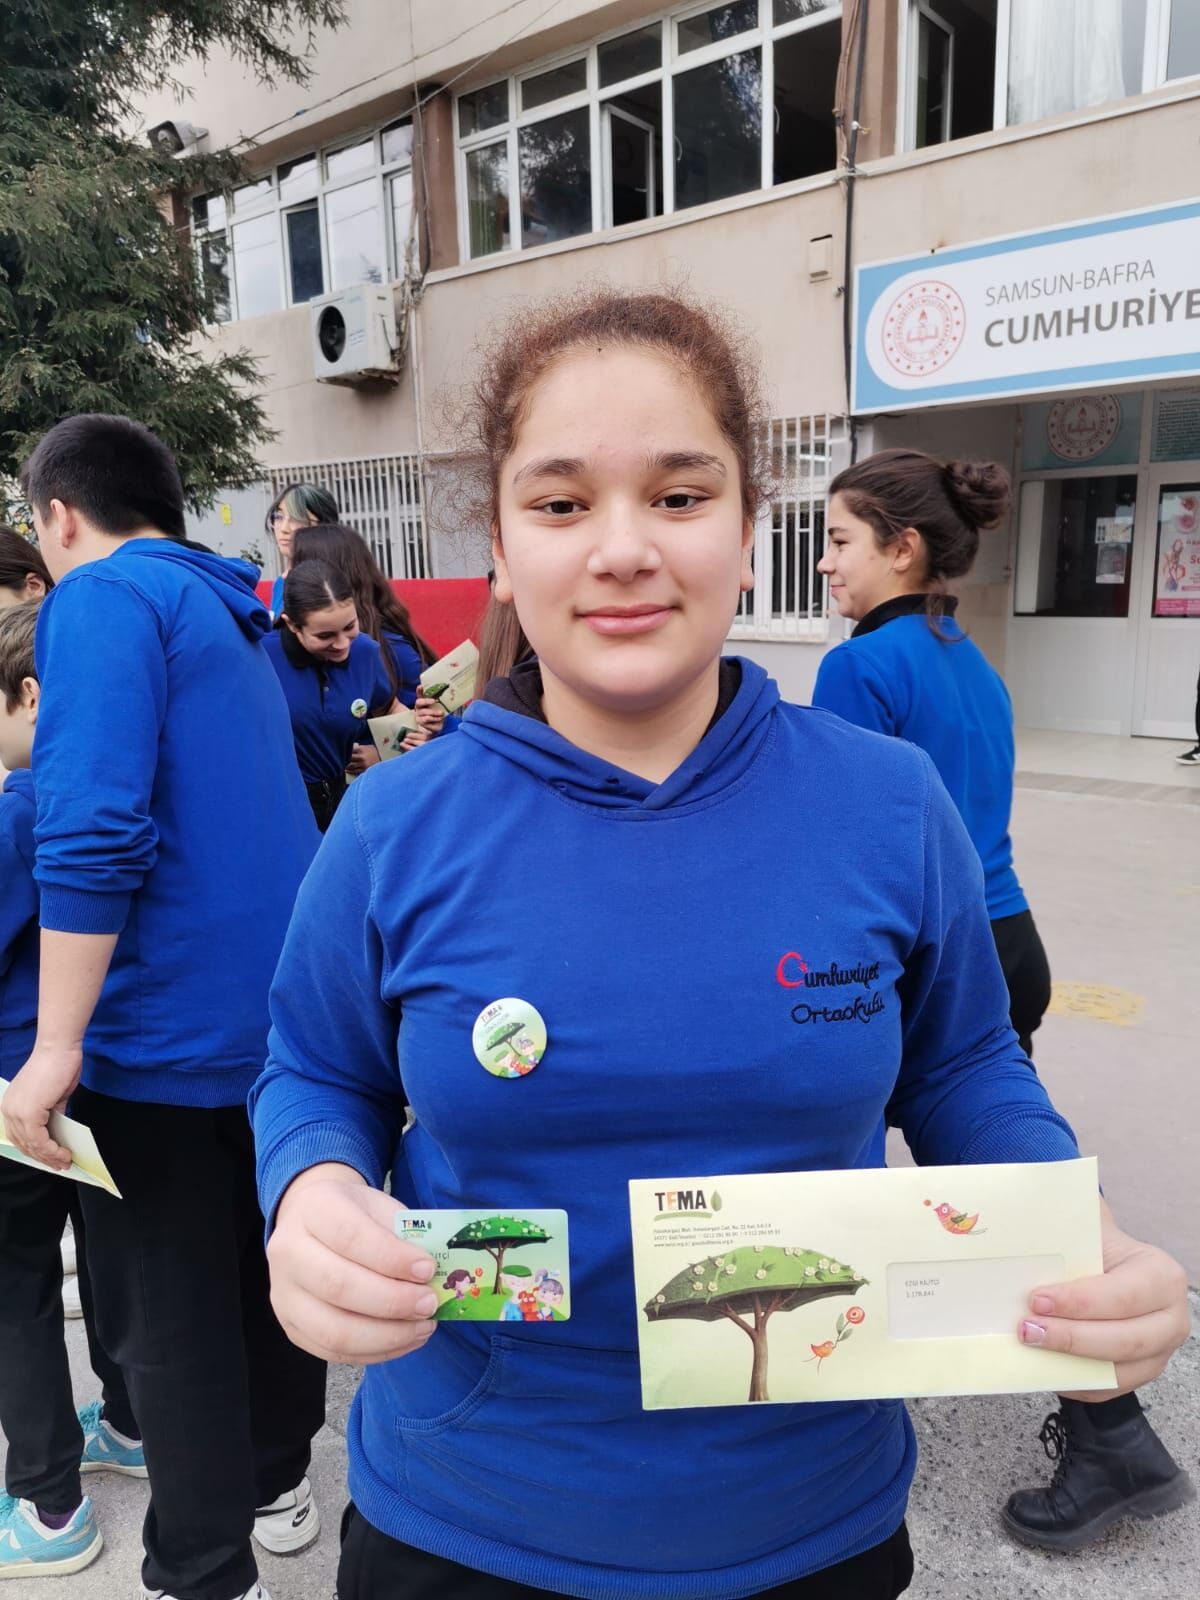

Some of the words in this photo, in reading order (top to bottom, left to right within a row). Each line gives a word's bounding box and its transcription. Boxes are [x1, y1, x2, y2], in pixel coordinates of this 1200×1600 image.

[985, 259, 1156, 307] SAMSUN-BAFRA
[984, 287, 1200, 348] CUMHURİYE
[776, 951, 880, 990] Cumhuriyet
[654, 1189, 707, 1212] TEMA
[402, 1219, 426, 1229] TEMA
